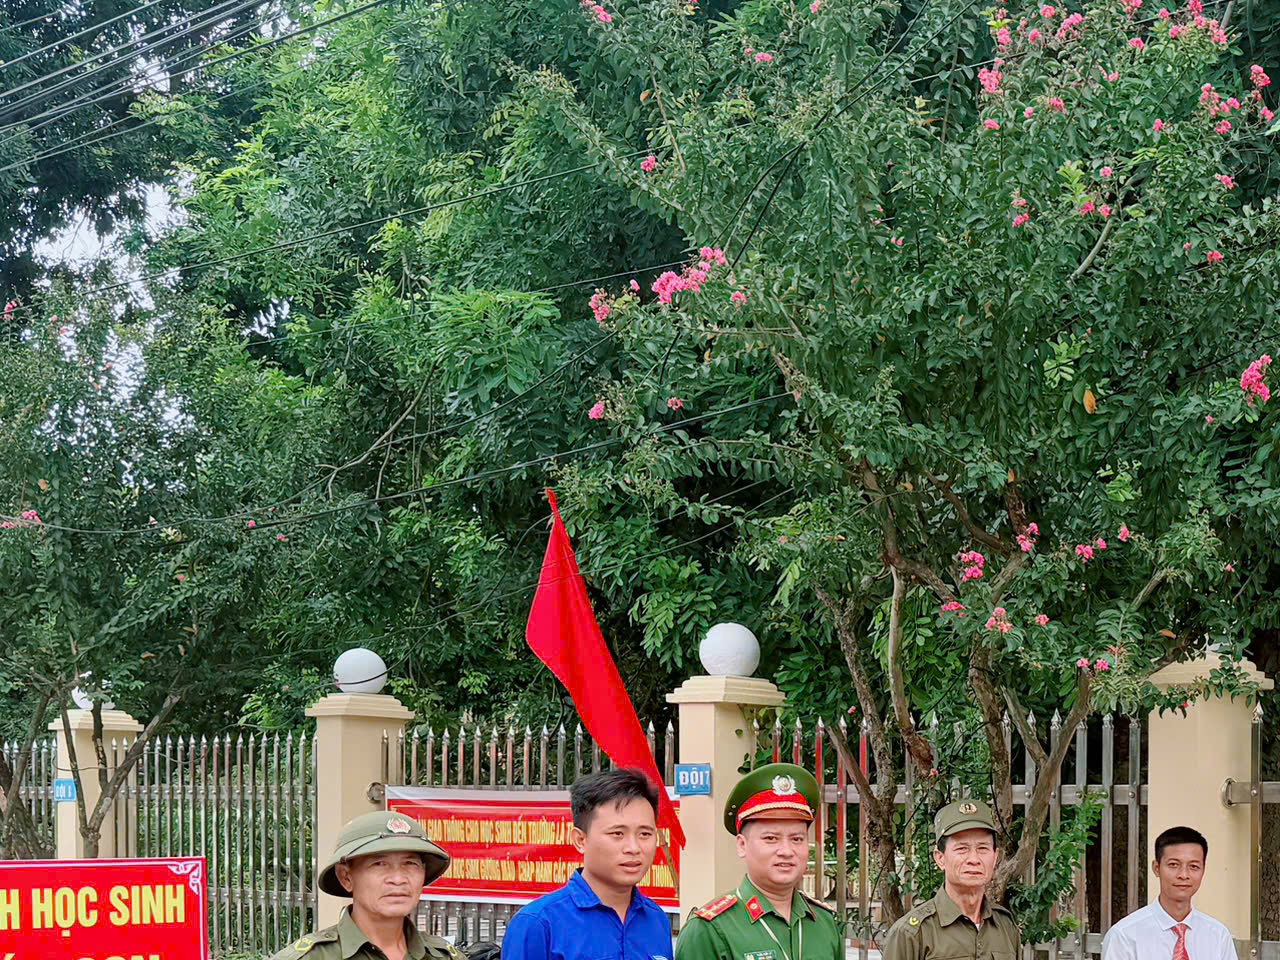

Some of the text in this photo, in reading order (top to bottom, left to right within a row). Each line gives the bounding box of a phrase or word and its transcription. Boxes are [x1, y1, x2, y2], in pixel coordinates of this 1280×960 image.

[679, 767, 704, 788] ĐỘI
[32, 886, 98, 937] HỌC
[109, 884, 185, 926] SINH
